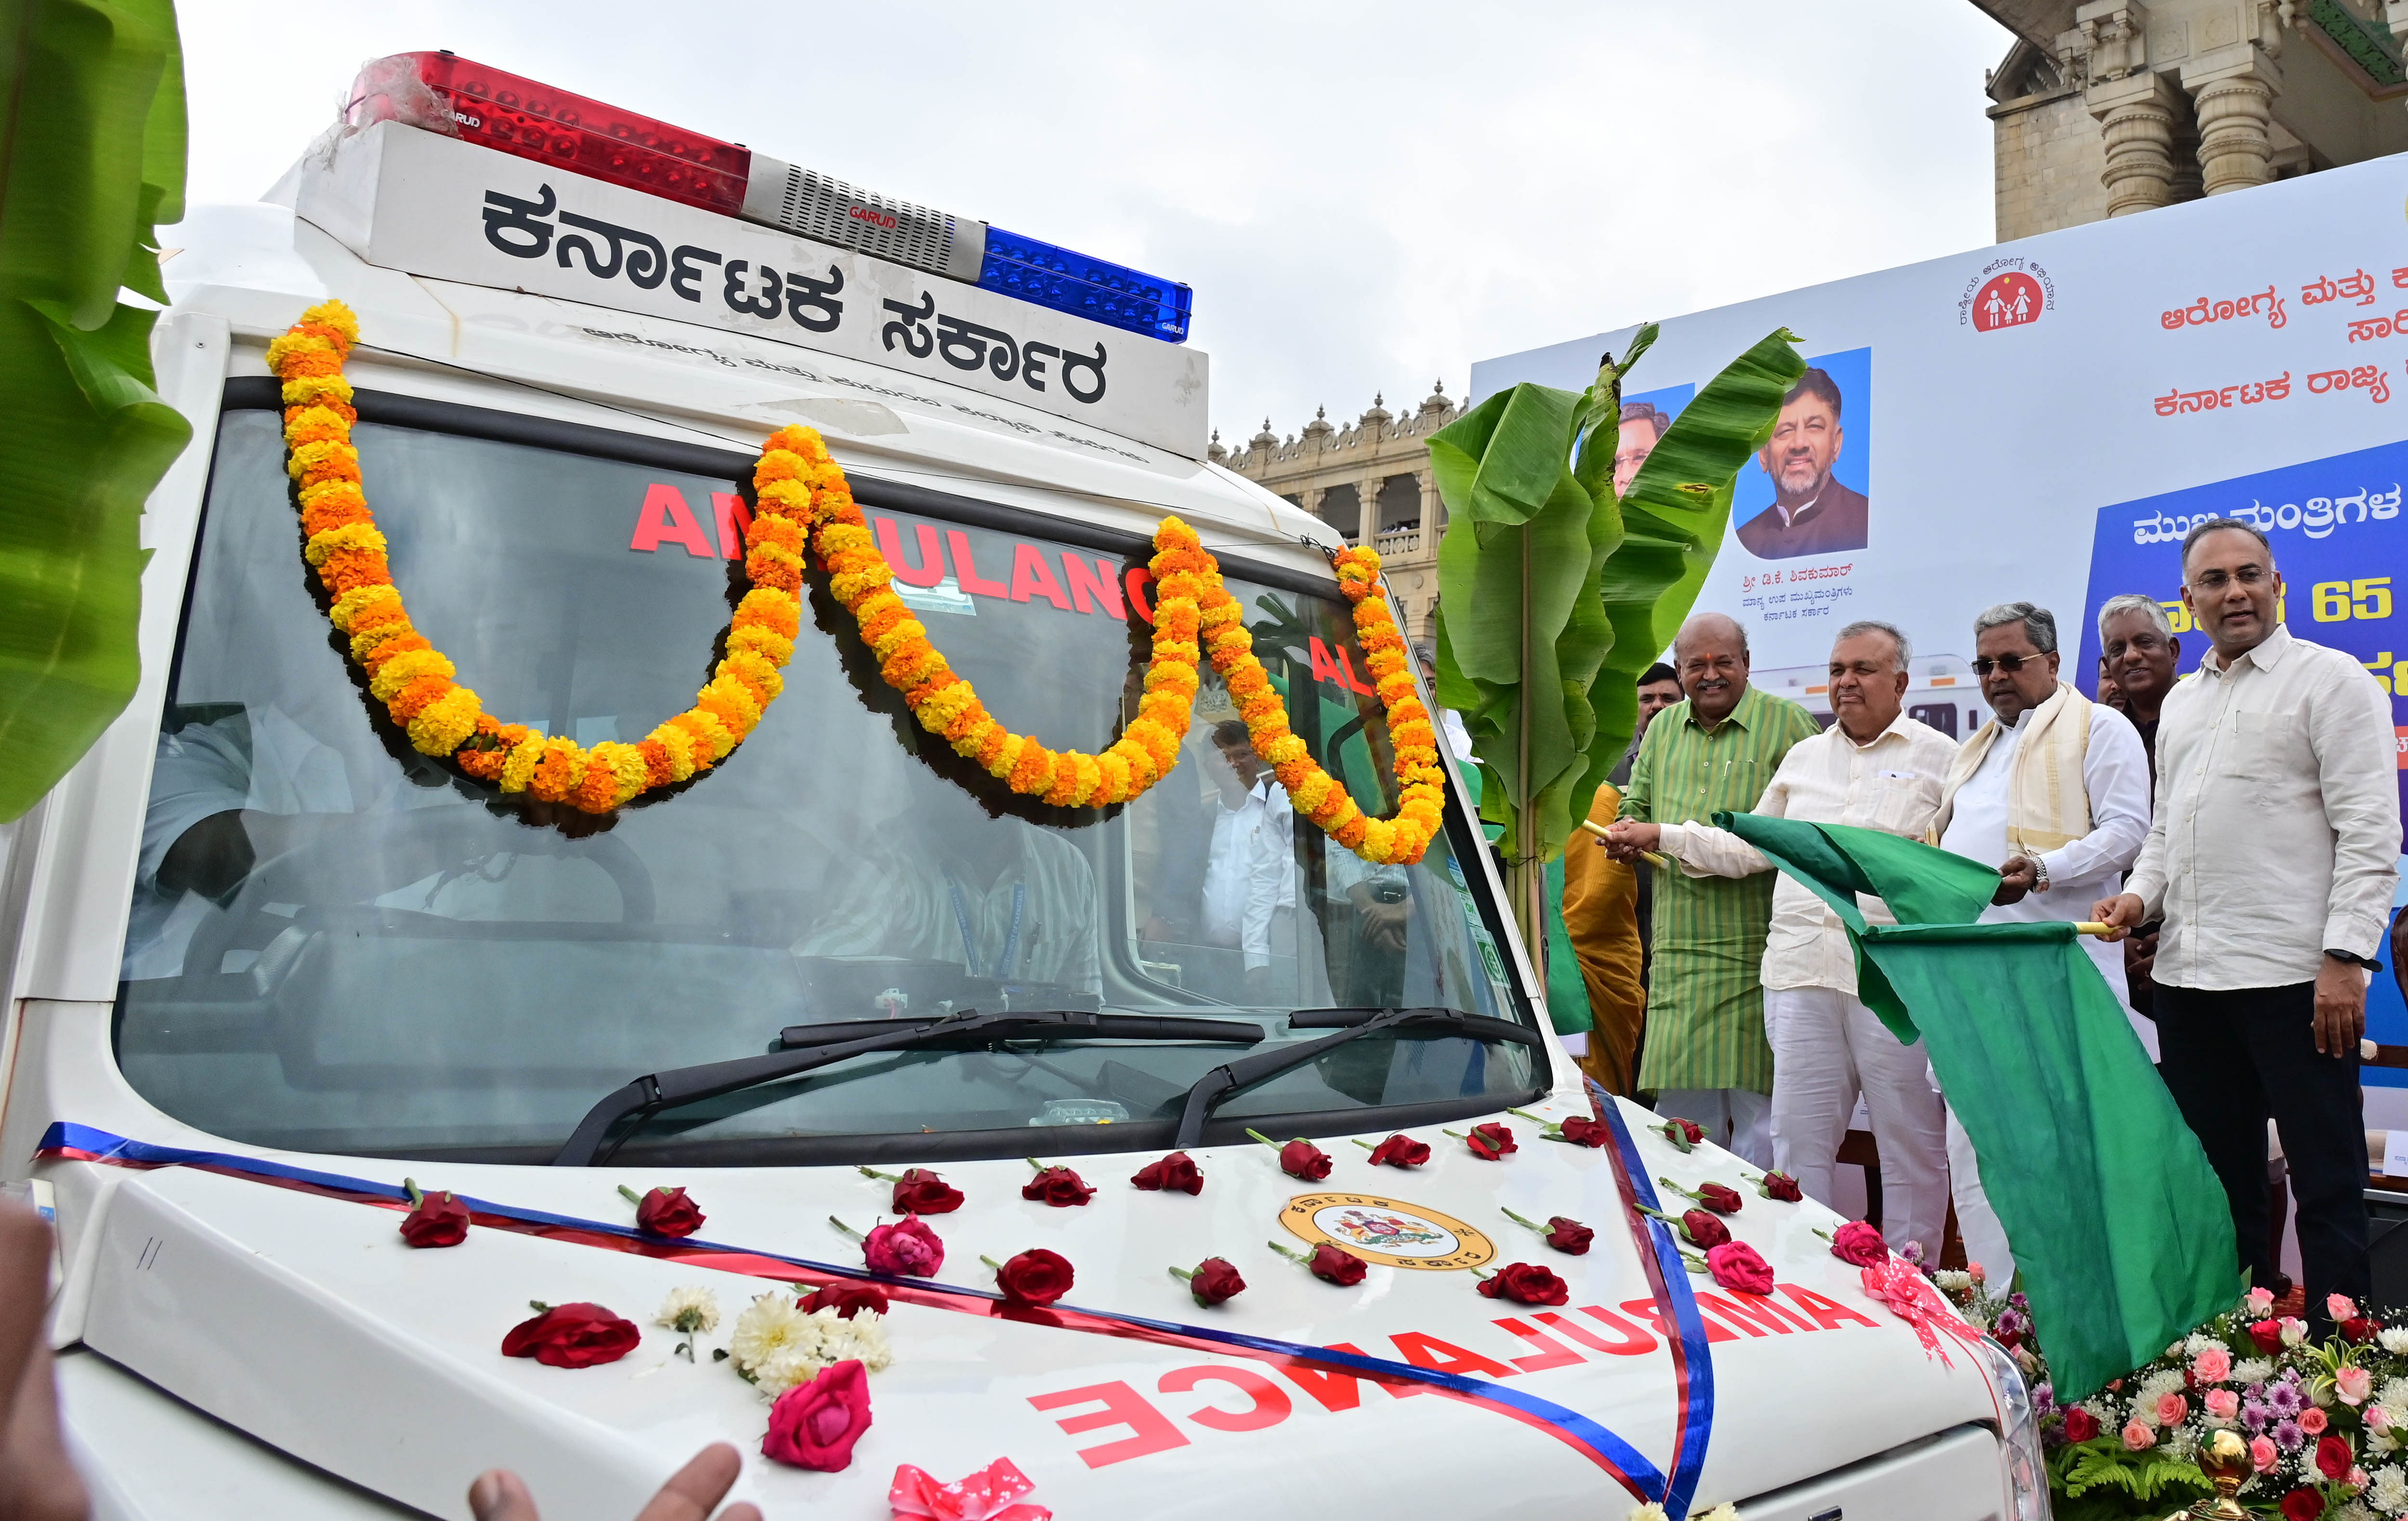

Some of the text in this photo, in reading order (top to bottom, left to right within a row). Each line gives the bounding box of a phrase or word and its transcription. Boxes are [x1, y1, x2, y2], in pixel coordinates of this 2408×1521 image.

[850, 206, 896, 229] GARUD
[483, 184, 1107, 404] ಕರ್ನಾಟಕ ಸರ್ಕಾರ
[1983, 257, 2024, 275] ಆರೋಗ್ಯ
[2030, 262, 2055, 311] ಅಭಿಯಾನ
[2161, 285, 2287, 329] ಆರೋಗ್ಯ
[2302, 268, 2376, 306] ಮತ್ತು
[1162, 322, 1184, 335] GARUD
[583, 327, 737, 367] ಆರೋಗ್ಯ
[740, 357, 823, 383] ಮತ್ತು
[828, 375, 942, 407] ಕುಟುಂಬ
[2155, 365, 2390, 417] ಕರ್ನಾಟಕ ರಾಜ್ಯ
[1742, 576, 1756, 593] ಶ್ರೀ
[1790, 563, 1853, 582] ಶಿವಕುಮಾರ್
[1742, 597, 1765, 611] ಮಾನ್ಯ
[1768, 593, 1786, 604] ಉಪ
[2313, 577, 2393, 623] 65
[1764, 605, 1830, 622] ಕರ್ನಾಟಕ ಸರ್ಕಾರ
[1309, 635, 1378, 698] AL
